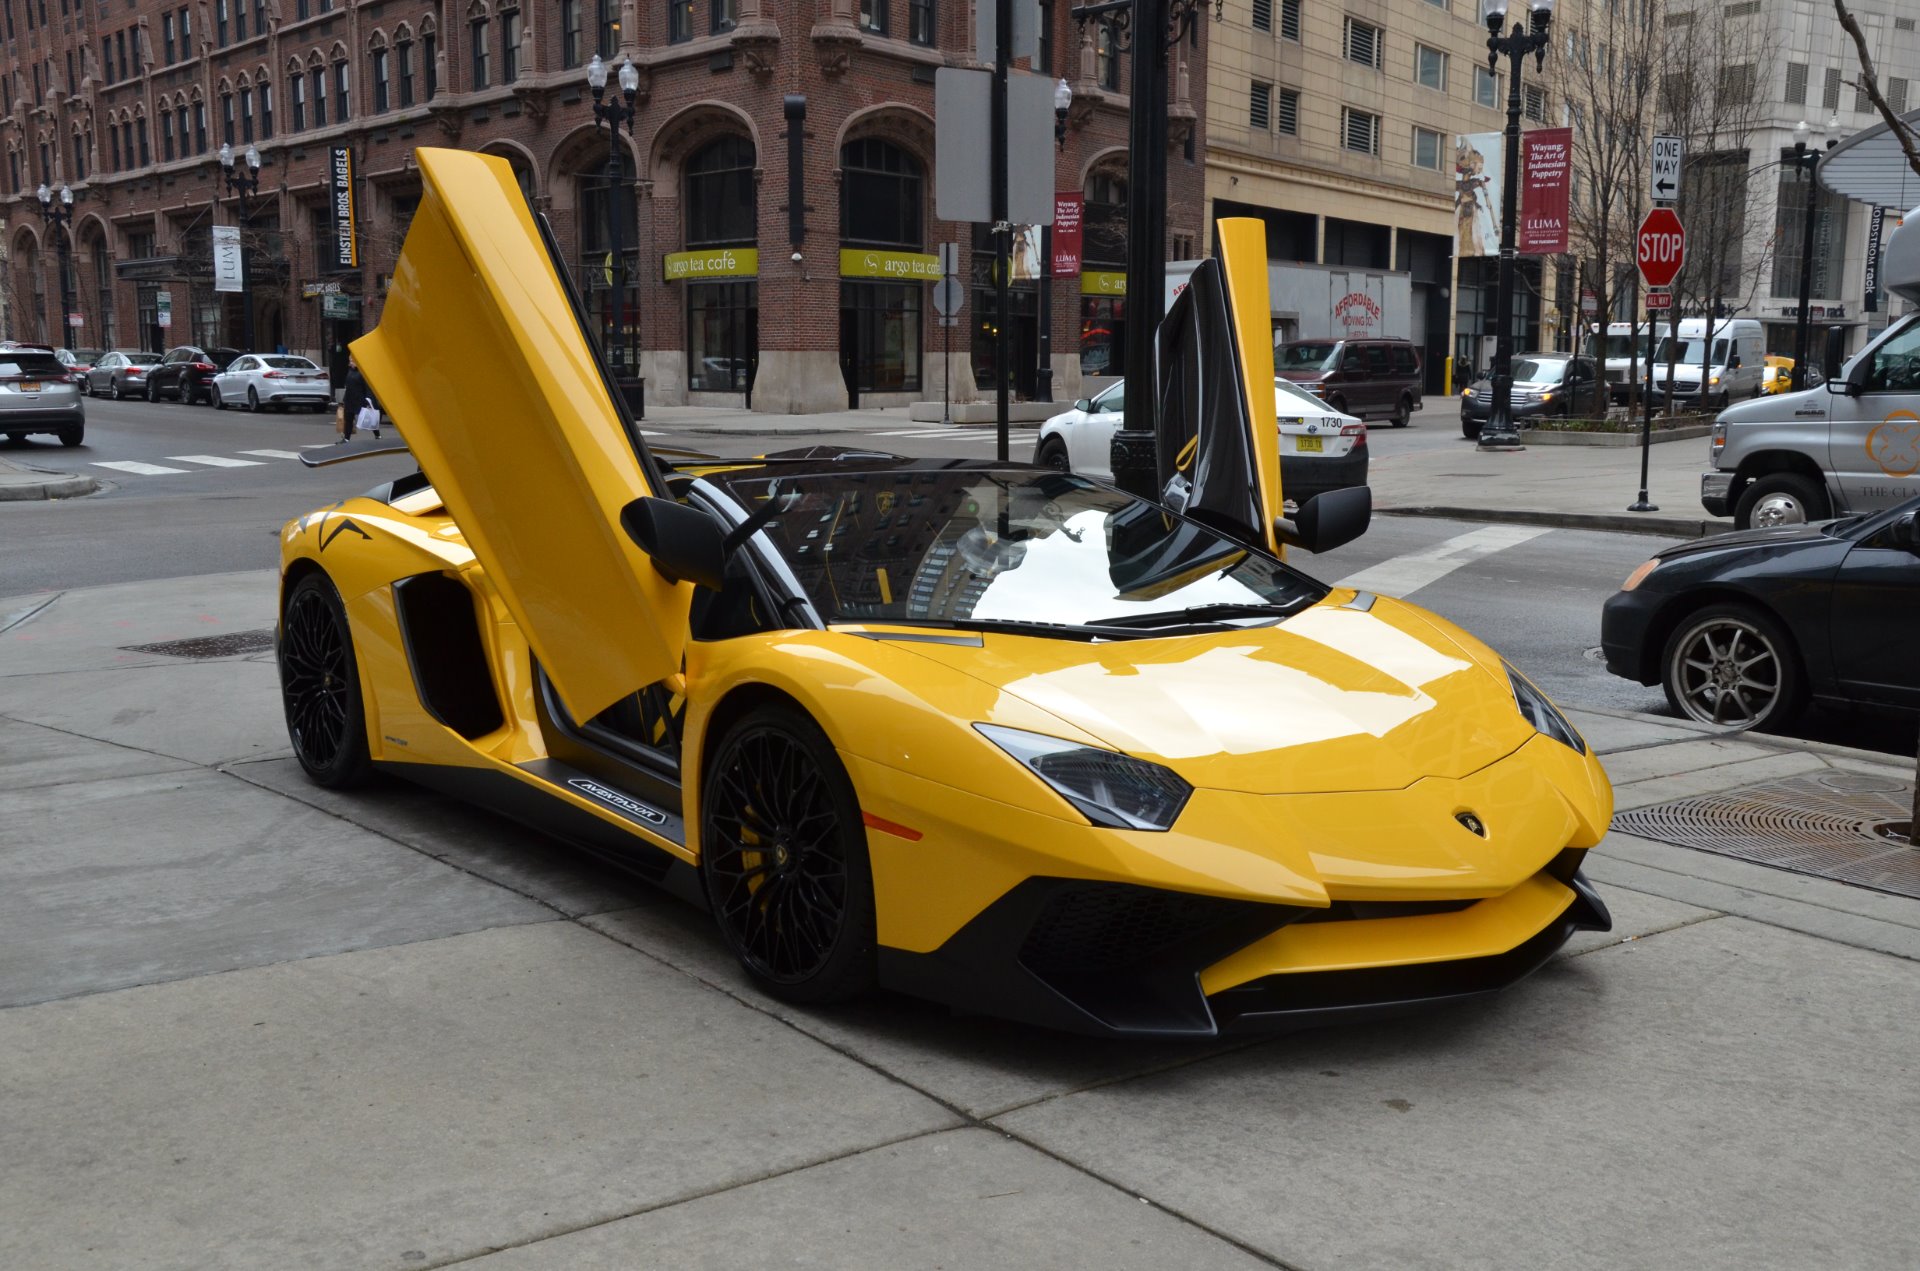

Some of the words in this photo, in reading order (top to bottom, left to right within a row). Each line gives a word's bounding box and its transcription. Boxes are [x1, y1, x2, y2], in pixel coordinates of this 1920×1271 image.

[1544, 152, 1556, 160] Art
[1558, 151, 1566, 160] of
[1656, 142, 1679, 158] ONE
[335, 149, 349, 188] BAGELS
[1528, 161, 1566, 169] Indonesian
[1655, 160, 1678, 175] WAY
[1532, 170, 1563, 179] Puppetry
[1528, 219, 1561, 229] LUMA
[339, 221, 352, 264] EINSTEIN
[1640, 233, 1682, 262] STOP
[672, 261, 688, 276] argo
[690, 258, 704, 271] tea
[707, 251, 736, 270] café
[884, 260, 910, 276] argo
[912, 259, 925, 273] tea
[1865, 267, 1875, 294] rack
[1335, 293, 1380, 320] AFFORDABLE
[1647, 296, 1657, 305] ALL
[1658, 296, 1669, 305] WAY
[1343, 316, 1365, 326] MOVING
[1321, 417, 1342, 428] 1730
[1862, 487, 1888, 497] THE
[581, 783, 657, 818] AVENTADOR
